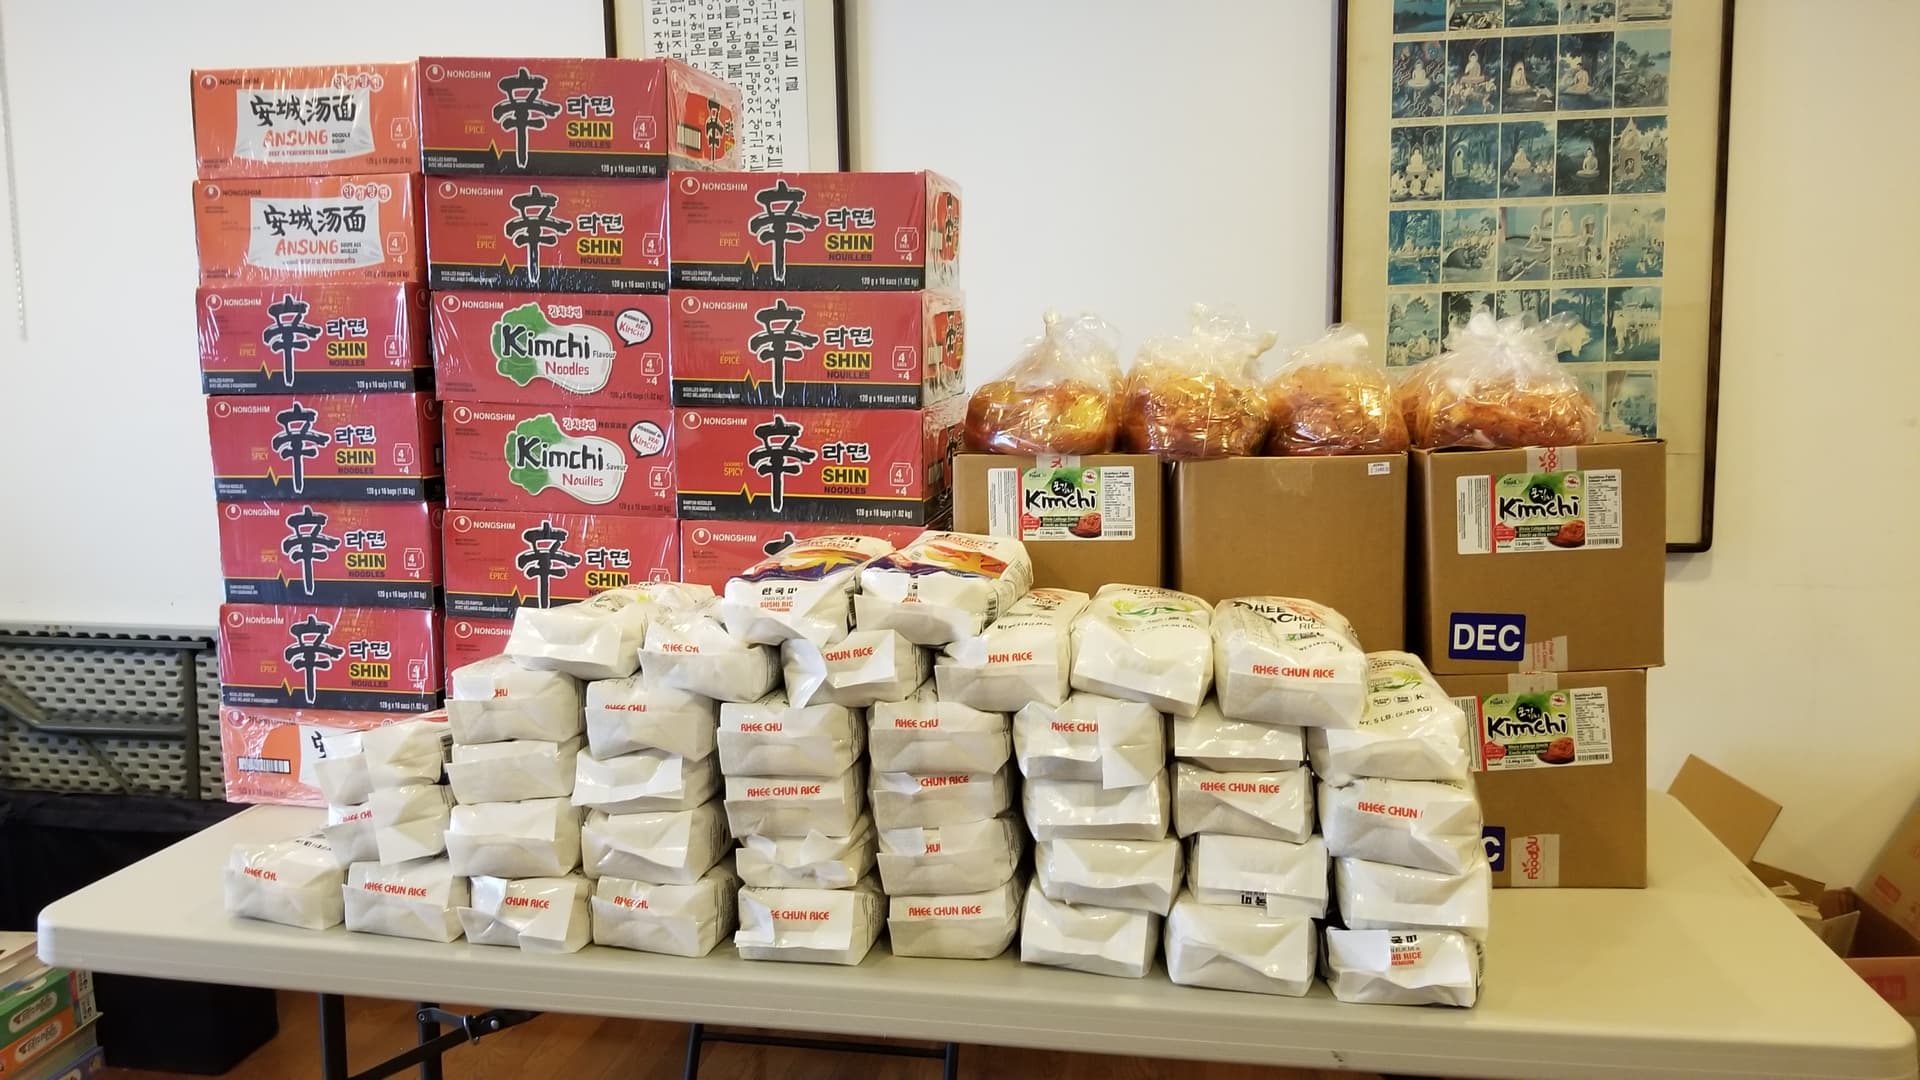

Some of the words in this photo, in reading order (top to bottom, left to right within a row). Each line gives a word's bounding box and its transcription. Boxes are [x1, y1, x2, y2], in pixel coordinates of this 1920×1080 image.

[446, 70, 491, 79] NONGSHIM
[249, 95, 357, 127] 安城汤面
[566, 95, 615, 118] 라면
[492, 66, 562, 168] 辛
[567, 122, 612, 138] SHIN
[638, 122, 647, 132] 4
[262, 129, 328, 147] ANSUNG
[460, 187, 504, 197] NONGSHIM
[702, 182, 748, 191] NONGSHIM
[263, 204, 367, 237] 安城汤面
[577, 212, 624, 235] 라면
[825, 207, 875, 230] 라면
[504, 184, 573, 283] 辛
[748, 179, 820, 281] 辛
[391, 238, 398, 247] 4
[578, 239, 622, 254] SHIN
[648, 239, 655, 248] 4
[827, 234, 873, 250] SHIN
[900, 235, 908, 244] 4
[274, 238, 339, 257] ANSUNG
[224, 298, 262, 307] NONGSHIM
[462, 300, 504, 310] NONGSHIM
[703, 301, 748, 310] NONGSHIM
[326, 317, 368, 337] 라면
[262, 294, 322, 387] 辛
[502, 324, 590, 359] Kimchi
[824, 326, 873, 348] 라면
[327, 343, 366, 356] SHIN
[389, 342, 396, 350] 4
[749, 298, 819, 399] 辛
[646, 359, 653, 368] 4
[825, 353, 871, 368] SHIN
[898, 353, 905, 362] 4
[545, 361, 590, 376] Noodles
[232, 406, 270, 414] NONGSHIM
[473, 412, 516, 421] NONGSHIM
[703, 417, 748, 426] NONGSHIM
[335, 425, 376, 445] 라면
[272, 401, 331, 493] 辛
[516, 436, 604, 471] Kimchi
[822, 442, 870, 465] 라면
[336, 450, 375, 464] SHIN
[398, 450, 405, 459] 4
[748, 414, 818, 513] 辛
[654, 473, 661, 482] 4
[723, 467, 743, 477] SPICY
[822, 468, 867, 484] SHIN
[895, 468, 903, 479] 4
[562, 473, 604, 487] Nouilles
[1025, 488, 1097, 510] Kimchi
[243, 508, 280, 516] NONGSHIM
[1499, 496, 1579, 520] Kimchi
[473, 521, 516, 530] NONGSHIM
[345, 530, 386, 551] 라면
[713, 533, 757, 542] NONGSHIM
[282, 504, 341, 596] 辛
[346, 554, 385, 568] SHIN
[408, 554, 415, 563] 4
[515, 519, 582, 609] 辛
[585, 548, 631, 569] 라면
[586, 573, 629, 588] SHIN
[653, 575, 661, 583] 4
[246, 616, 284, 624] NONGSHIM
[1452, 622, 1521, 652] DEC
[348, 640, 391, 659] 라면
[825, 649, 851, 661] CHUN
[852, 647, 873, 658] RICE
[284, 613, 345, 705] 辛
[988, 653, 1011, 664] HUN
[1012, 651, 1033, 662] RICE
[350, 664, 389, 678] SHIN
[411, 665, 419, 675] 4
[1252, 664, 1279, 676] RHEE
[1281, 667, 1310, 678] CHUN
[1312, 668, 1335, 679] RICE
[740, 723, 763, 733] RHEE
[764, 722, 783, 732] CHU
[894, 719, 918, 729] RHEE
[919, 719, 939, 729] CHU
[1051, 721, 1075, 732] RHEE
[1076, 722, 1099, 733] CHU
[1487, 713, 1567, 739] Kimchi
[920, 776, 947, 788] CHUN
[948, 774, 970, 785] RICE
[1200, 781, 1226, 792] RHEE
[1228, 782, 1257, 793] CHUN
[1258, 783, 1280, 794] RICE
[747, 787, 771, 798] RHEE
[772, 786, 799, 796] CHUN
[800, 784, 821, 795] RICE
[1357, 801, 1386, 814] RHEE
[1387, 806, 1418, 818] CHUN
[364, 881, 383, 892] RHEE
[384, 884, 406, 895] CHUN
[408, 887, 427, 897] RICE
[505, 896, 529, 907] CHUN
[530, 898, 550, 909] RICE
[781, 910, 807, 921] CHUN
[809, 910, 830, 921] RICE
[908, 906, 932, 917] RHEE
[933, 906, 959, 917] CHUN
[960, 905, 982, 915] RICE
